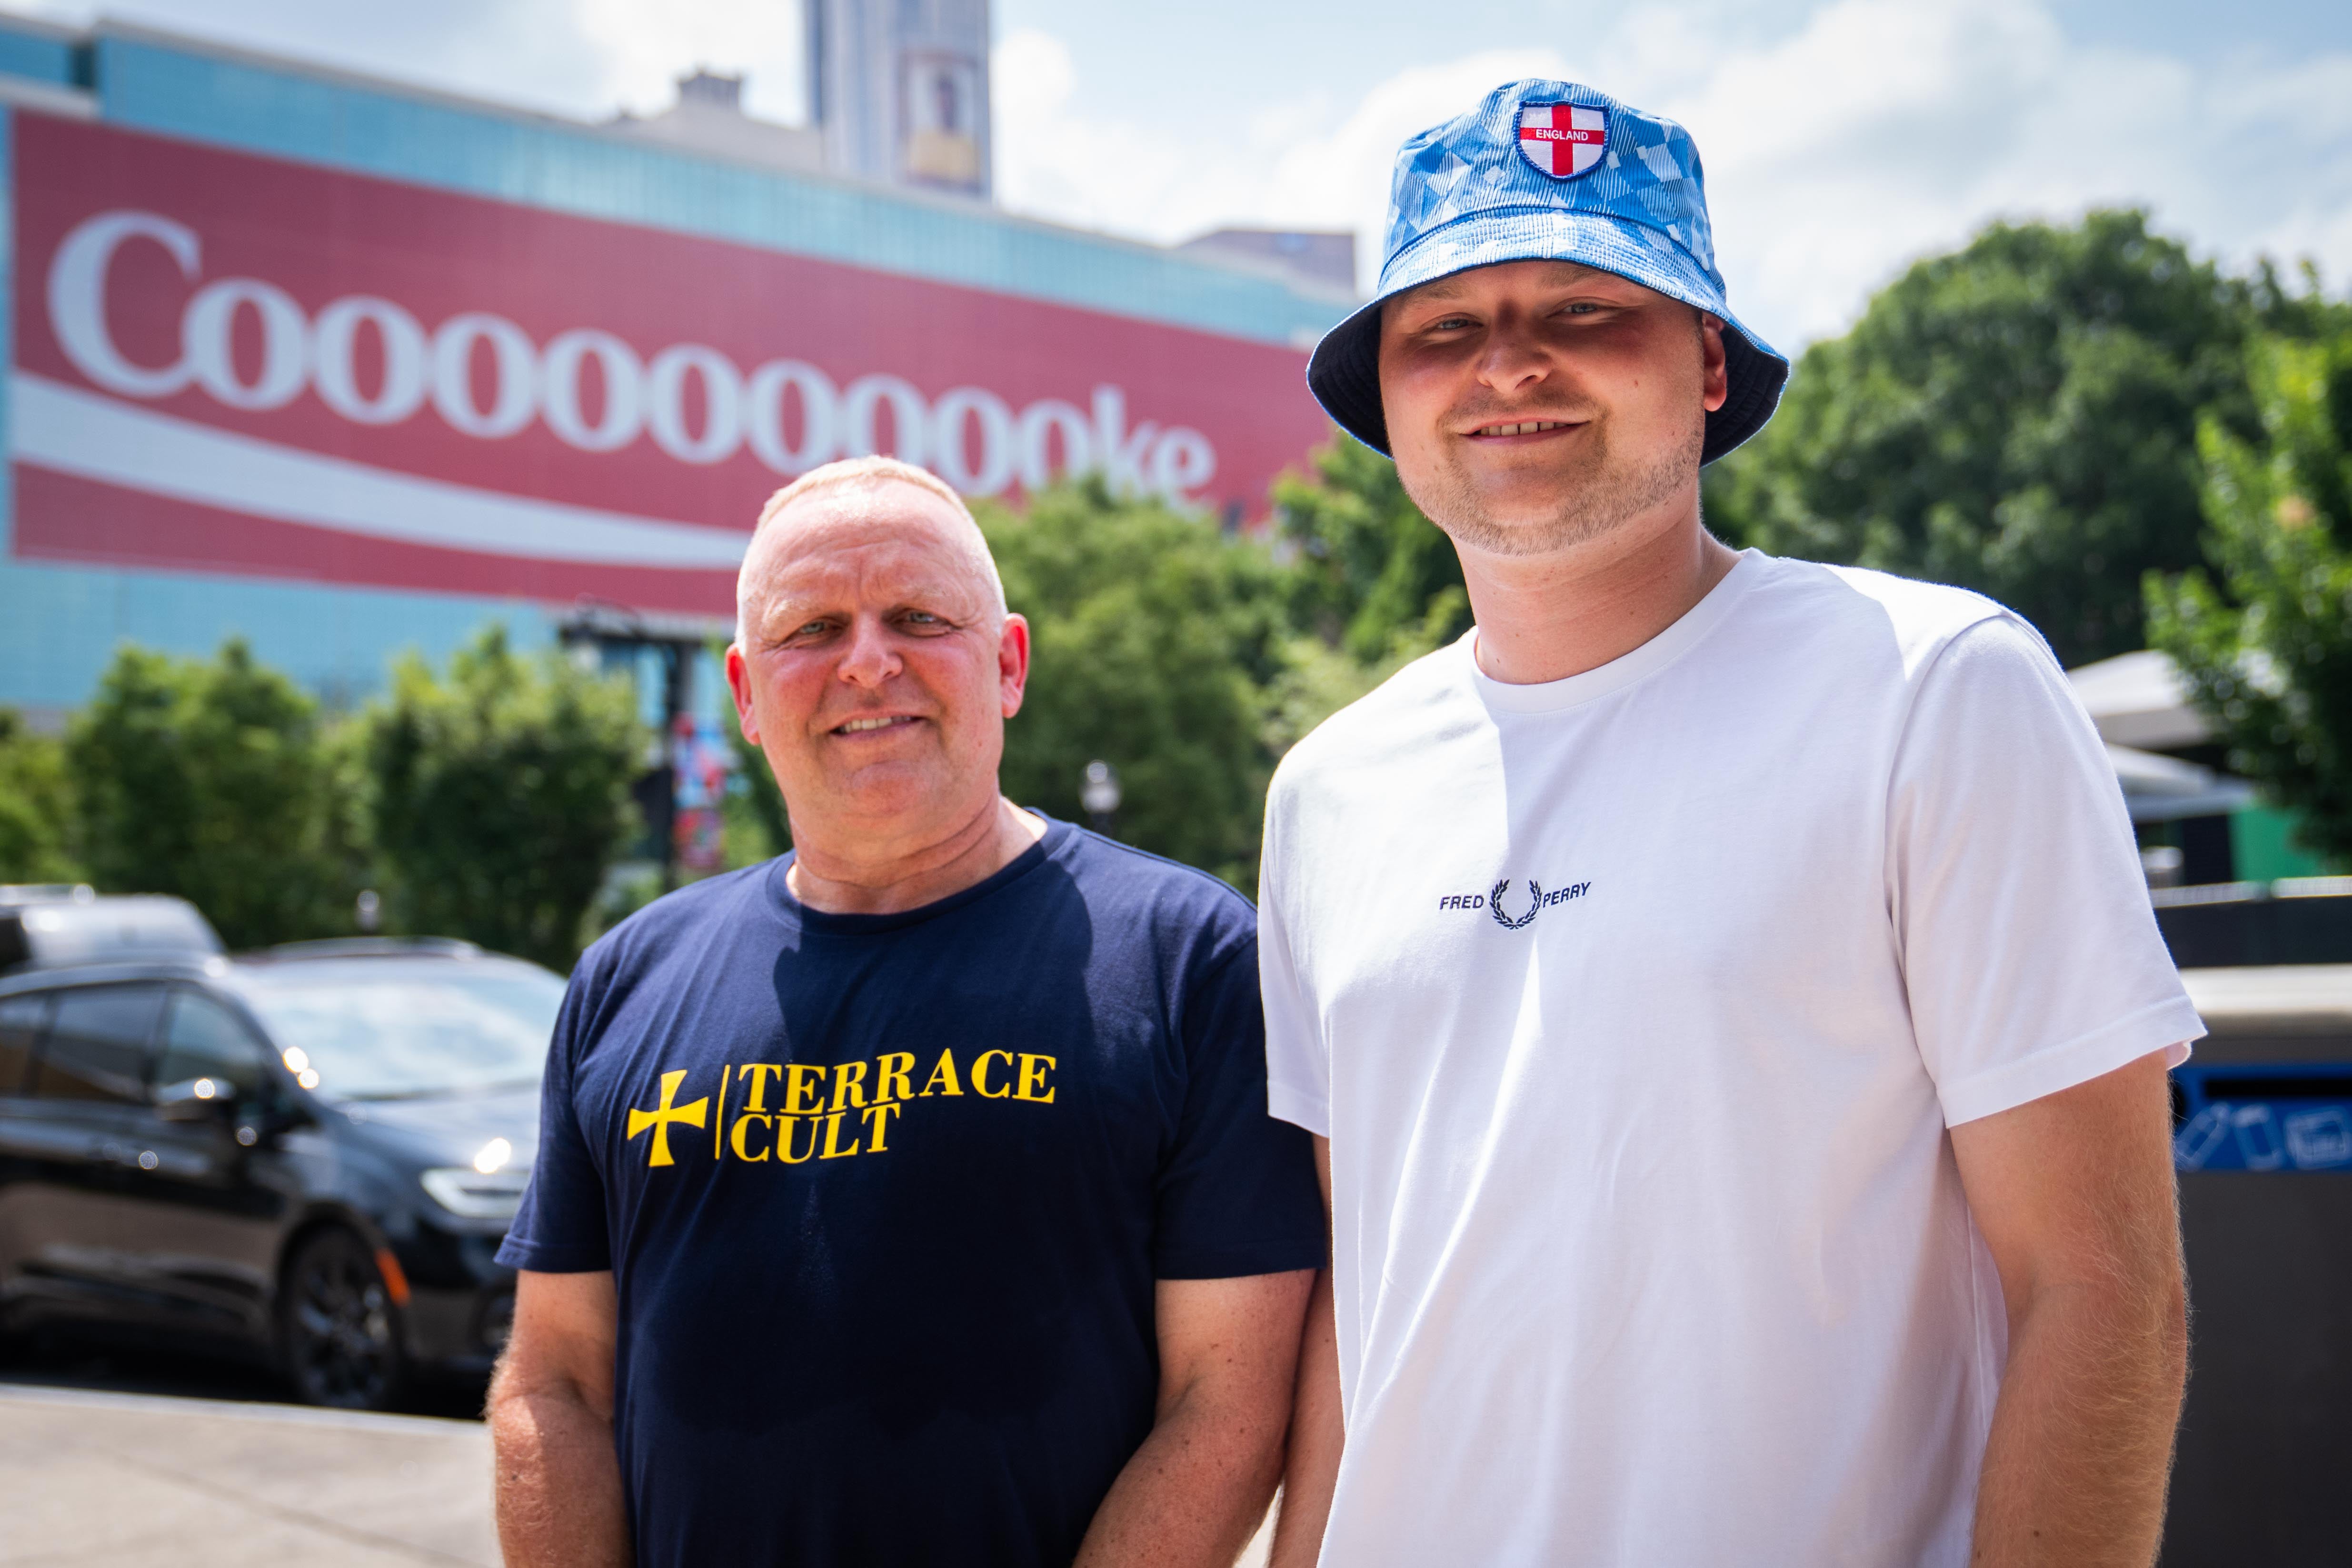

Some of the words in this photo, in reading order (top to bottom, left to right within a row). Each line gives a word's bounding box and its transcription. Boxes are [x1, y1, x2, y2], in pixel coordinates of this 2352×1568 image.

[1535, 129, 1589, 141] ENGLAND
[1440, 895, 1485, 910] FRED
[1543, 881, 1591, 908] PERRY
[738, 1048, 1056, 1115] TERRACE
[730, 1102, 900, 1164] CULT
